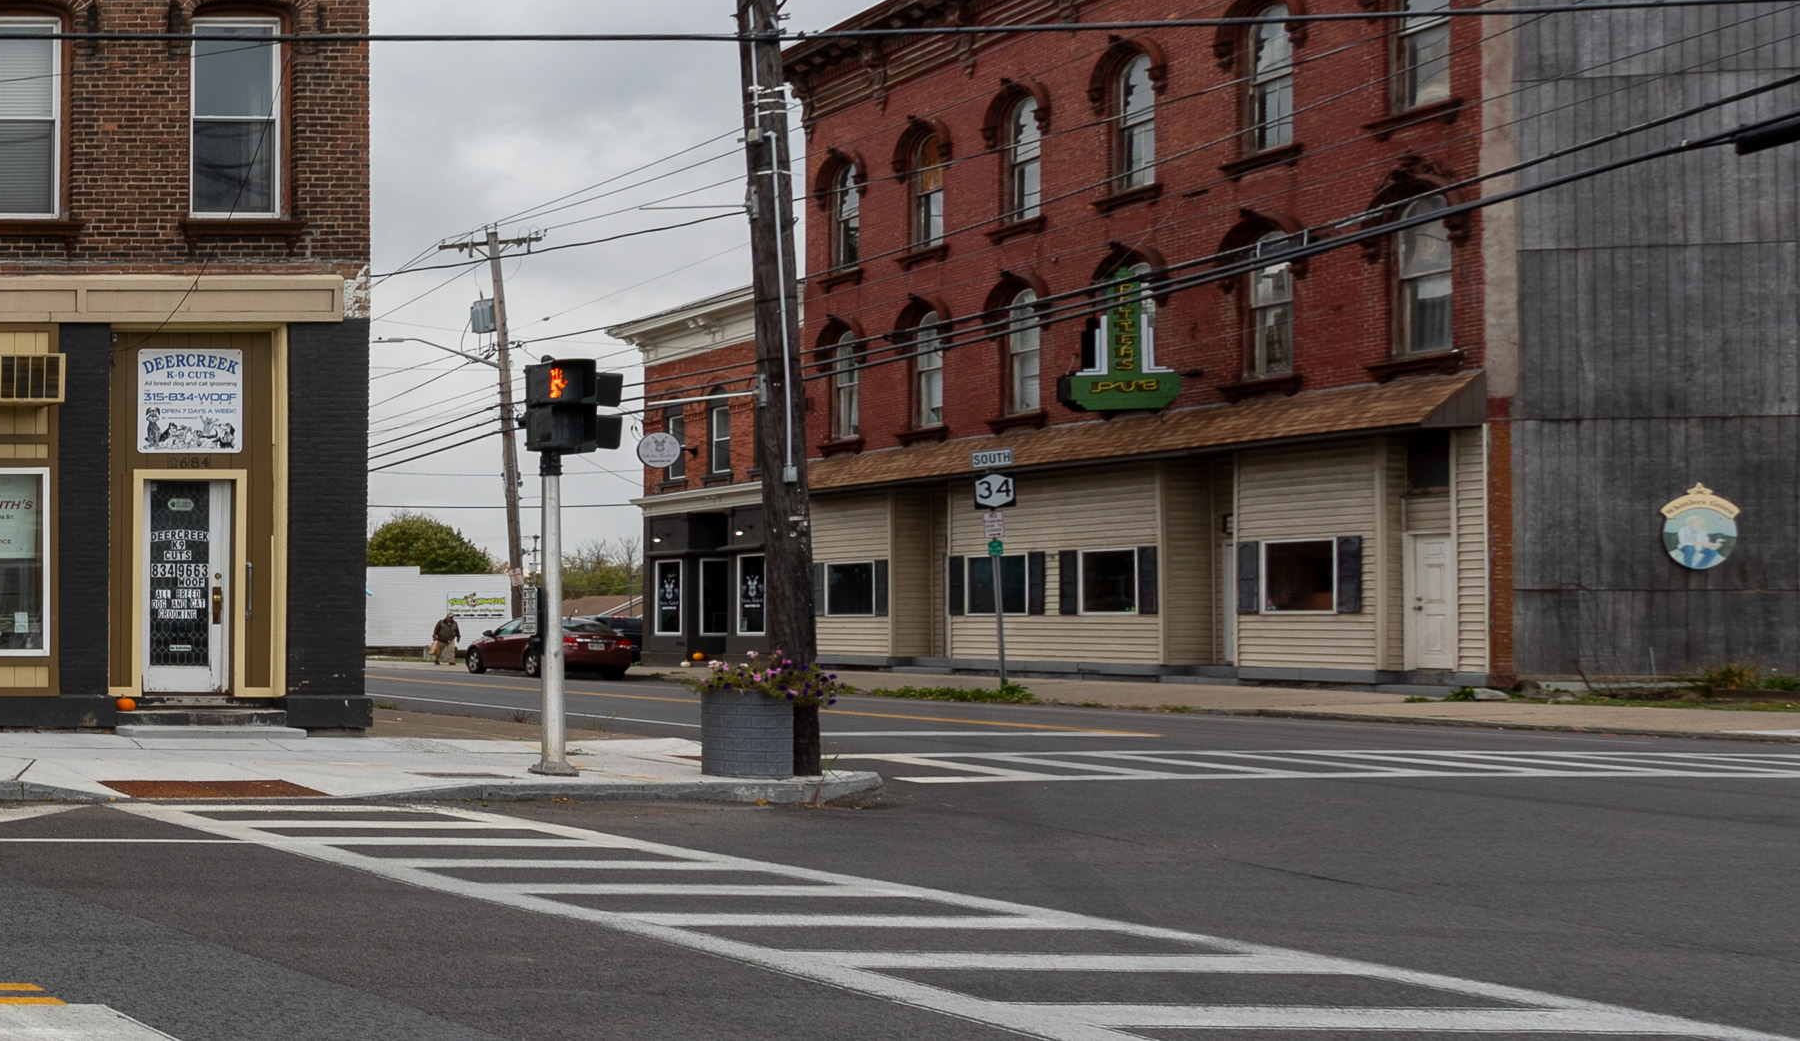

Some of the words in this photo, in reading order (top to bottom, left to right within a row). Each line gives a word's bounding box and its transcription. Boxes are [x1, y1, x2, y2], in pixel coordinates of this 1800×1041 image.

[142, 353, 239, 375] DEERCREEK
[166, 371, 184, 379] K-9
[188, 371, 215, 379] CUTS
[1091, 379, 1158, 393] PUB
[144, 392, 237, 401] 315-834-WOOF
[170, 457, 209, 468] 2684
[973, 452, 1011, 465] SOUTH
[978, 479, 1011, 499] 34
[151, 530, 209, 541] DEERCREEK
[172, 540, 185, 550] K9
[164, 551, 191, 560] CUTS
[152, 564, 174, 577] 834
[178, 564, 208, 577] 9663
[178, 578, 205, 587] WOOF
[156, 590, 170, 598] ALL
[176, 589, 200, 598] BREED
[152, 600, 167, 609] DOG
[172, 599, 187, 608] AND
[190, 599, 205, 608] CAT
[158, 609, 197, 618] GROOMING
